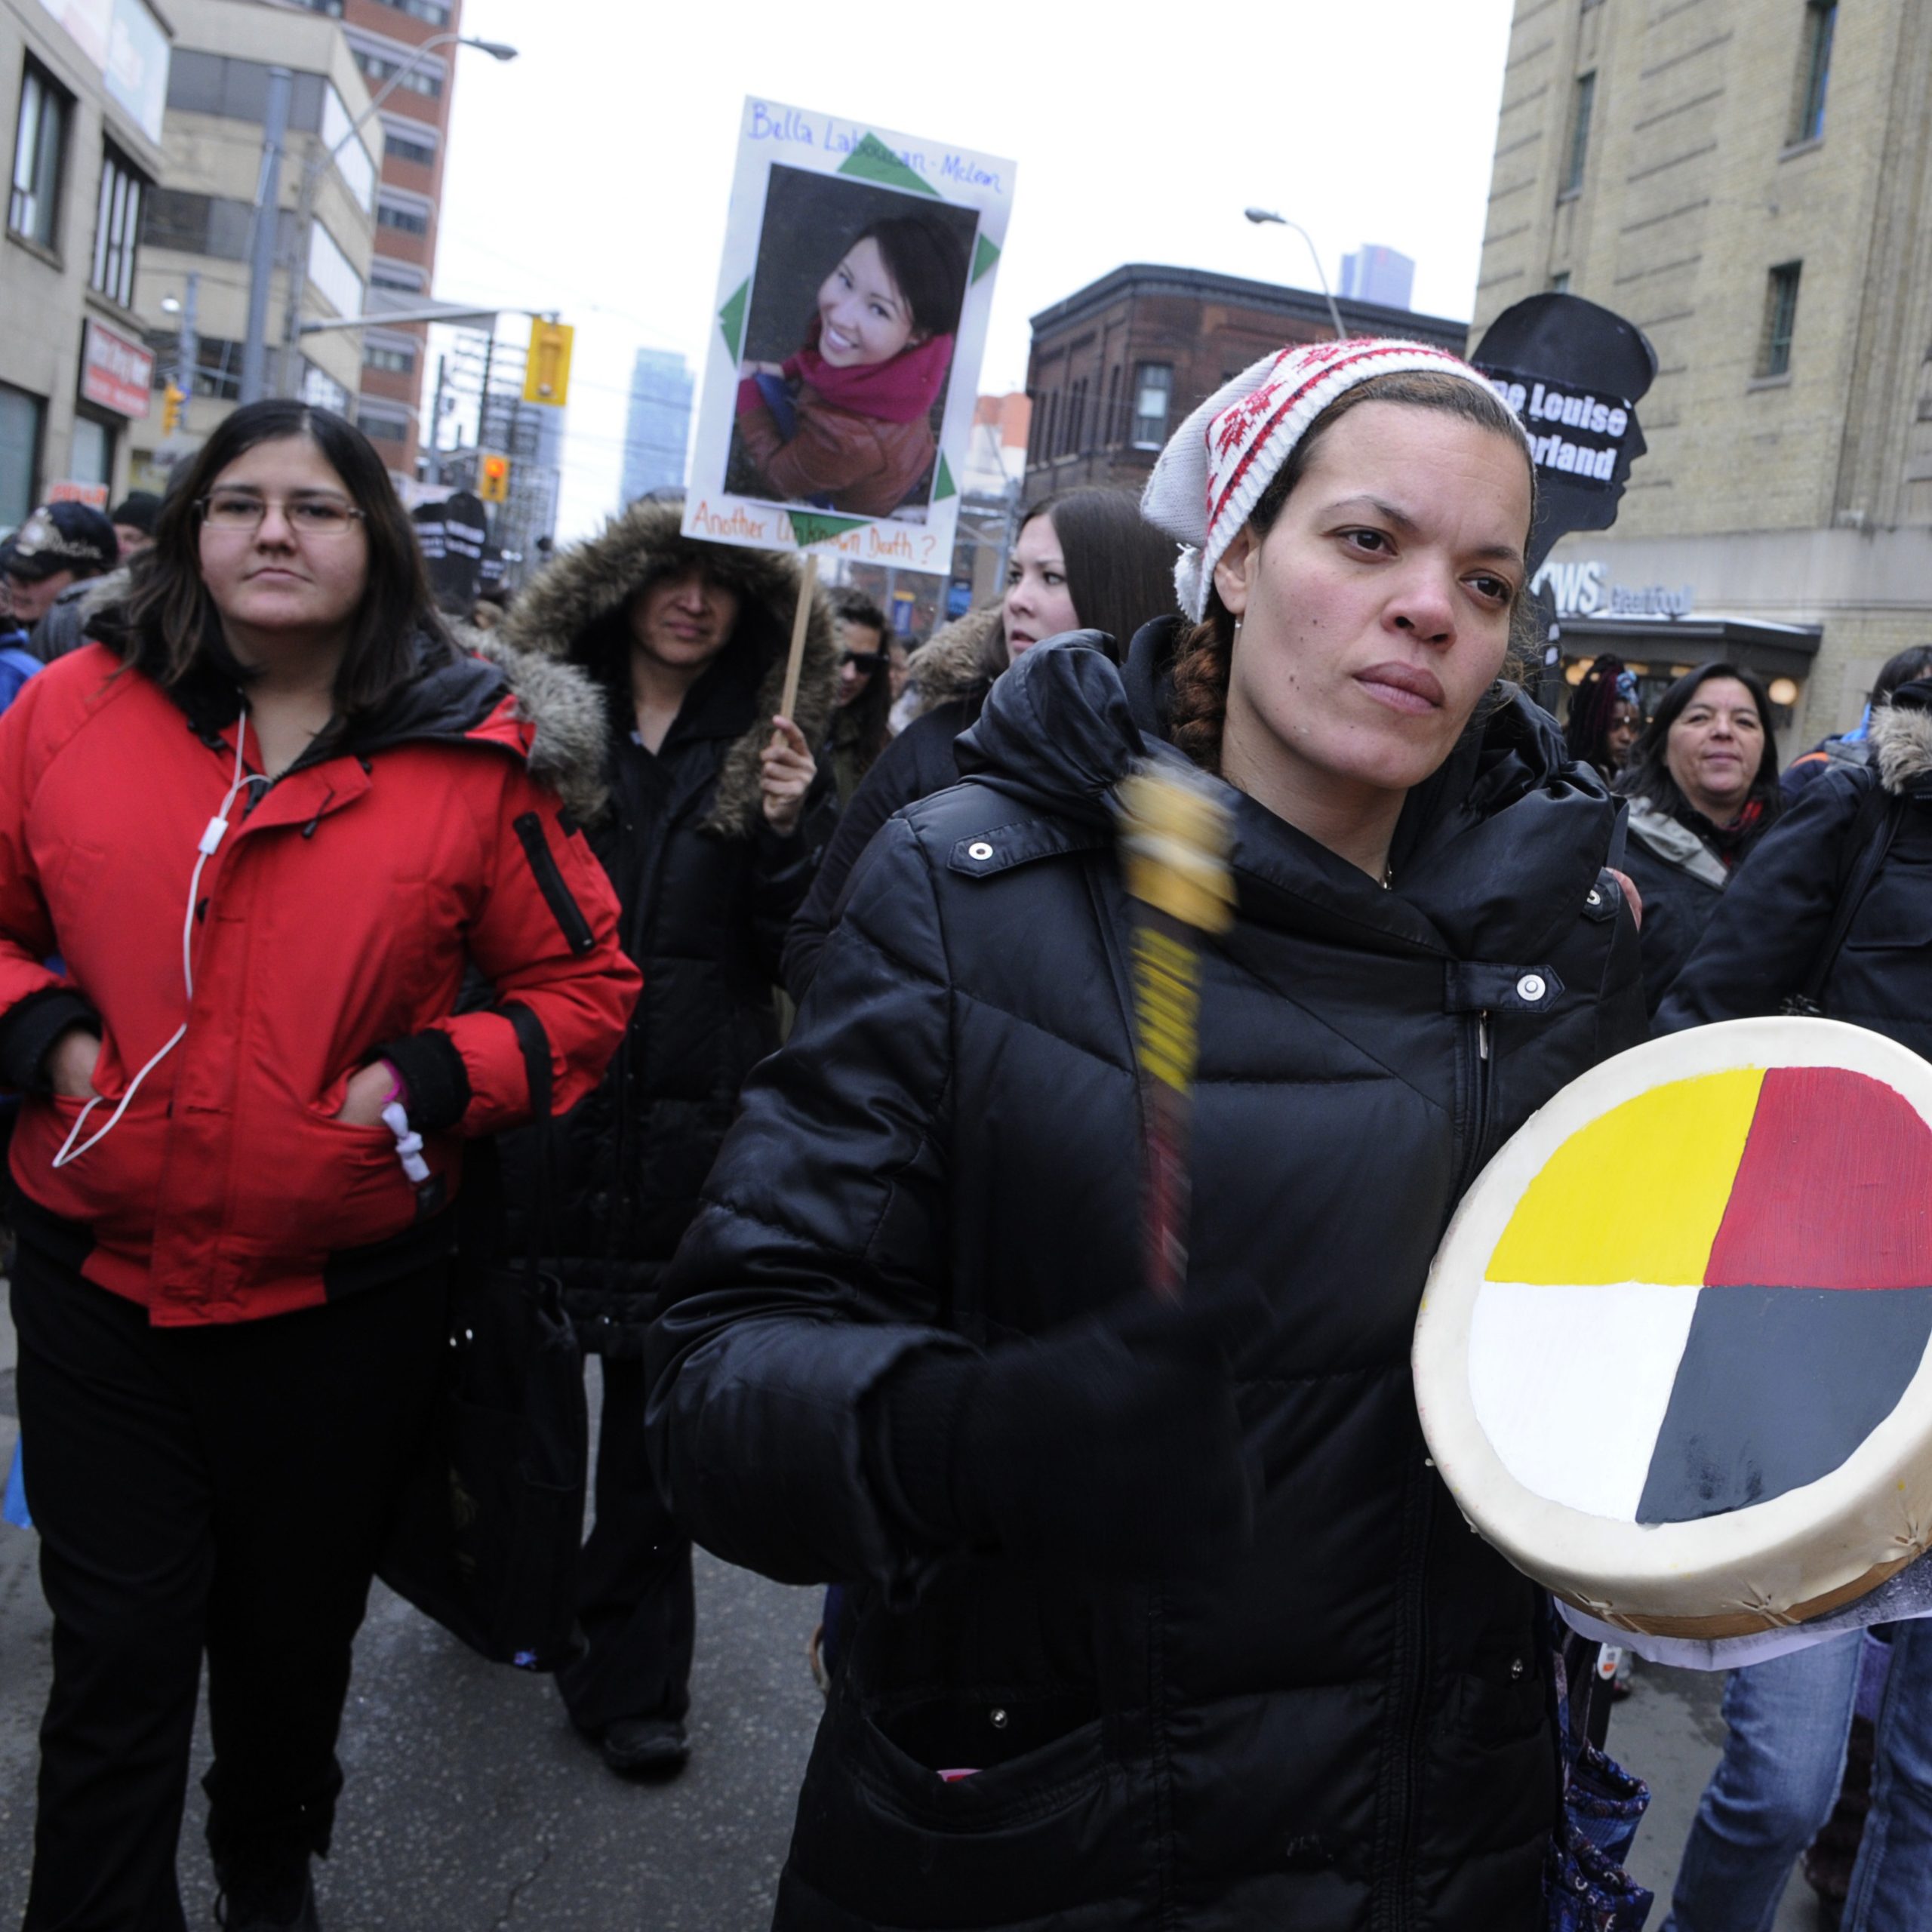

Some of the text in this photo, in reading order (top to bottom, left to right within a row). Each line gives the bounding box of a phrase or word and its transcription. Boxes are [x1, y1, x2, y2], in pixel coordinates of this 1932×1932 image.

[748, 101, 813, 145] Bella
[1528, 383, 1628, 437] Louise
[691, 500, 765, 540] Another
